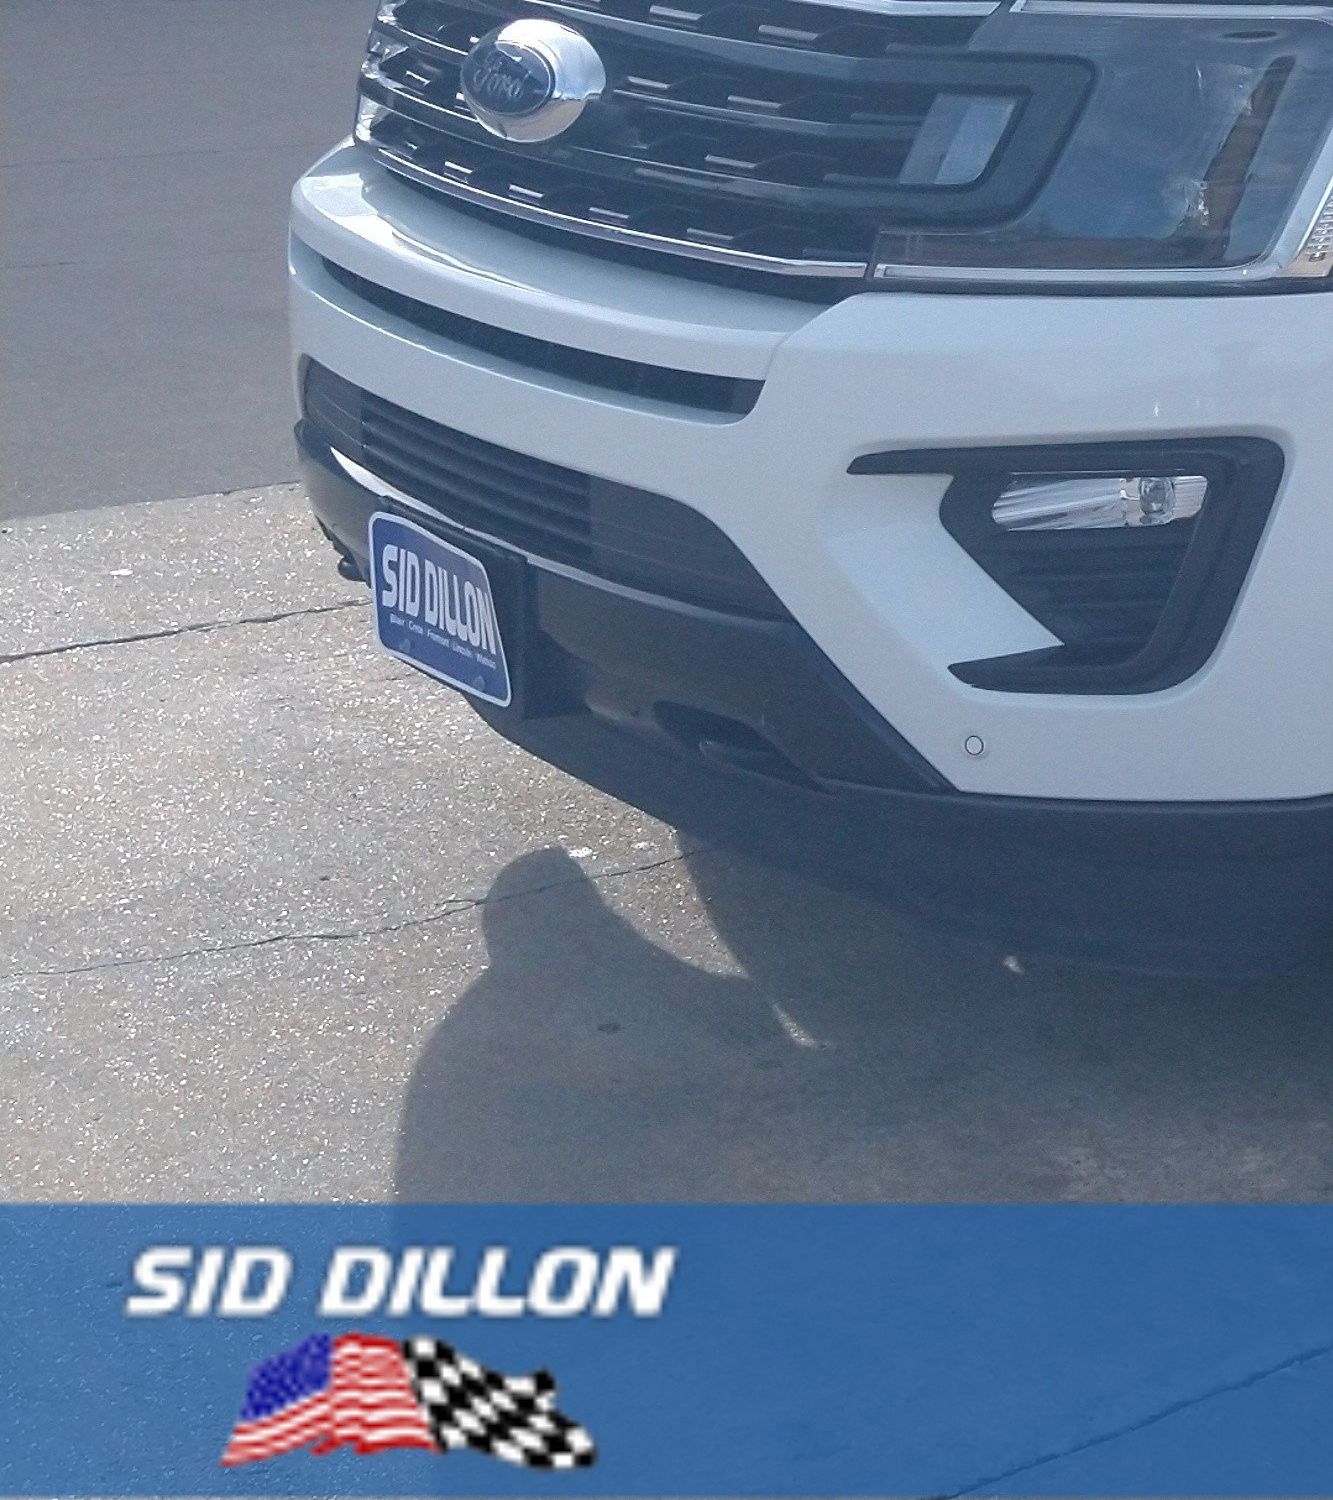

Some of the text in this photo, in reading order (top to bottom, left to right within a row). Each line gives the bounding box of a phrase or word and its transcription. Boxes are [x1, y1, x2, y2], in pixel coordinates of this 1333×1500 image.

[473, 51, 533, 101] Ford
[381, 543, 497, 655] SID DILLON
